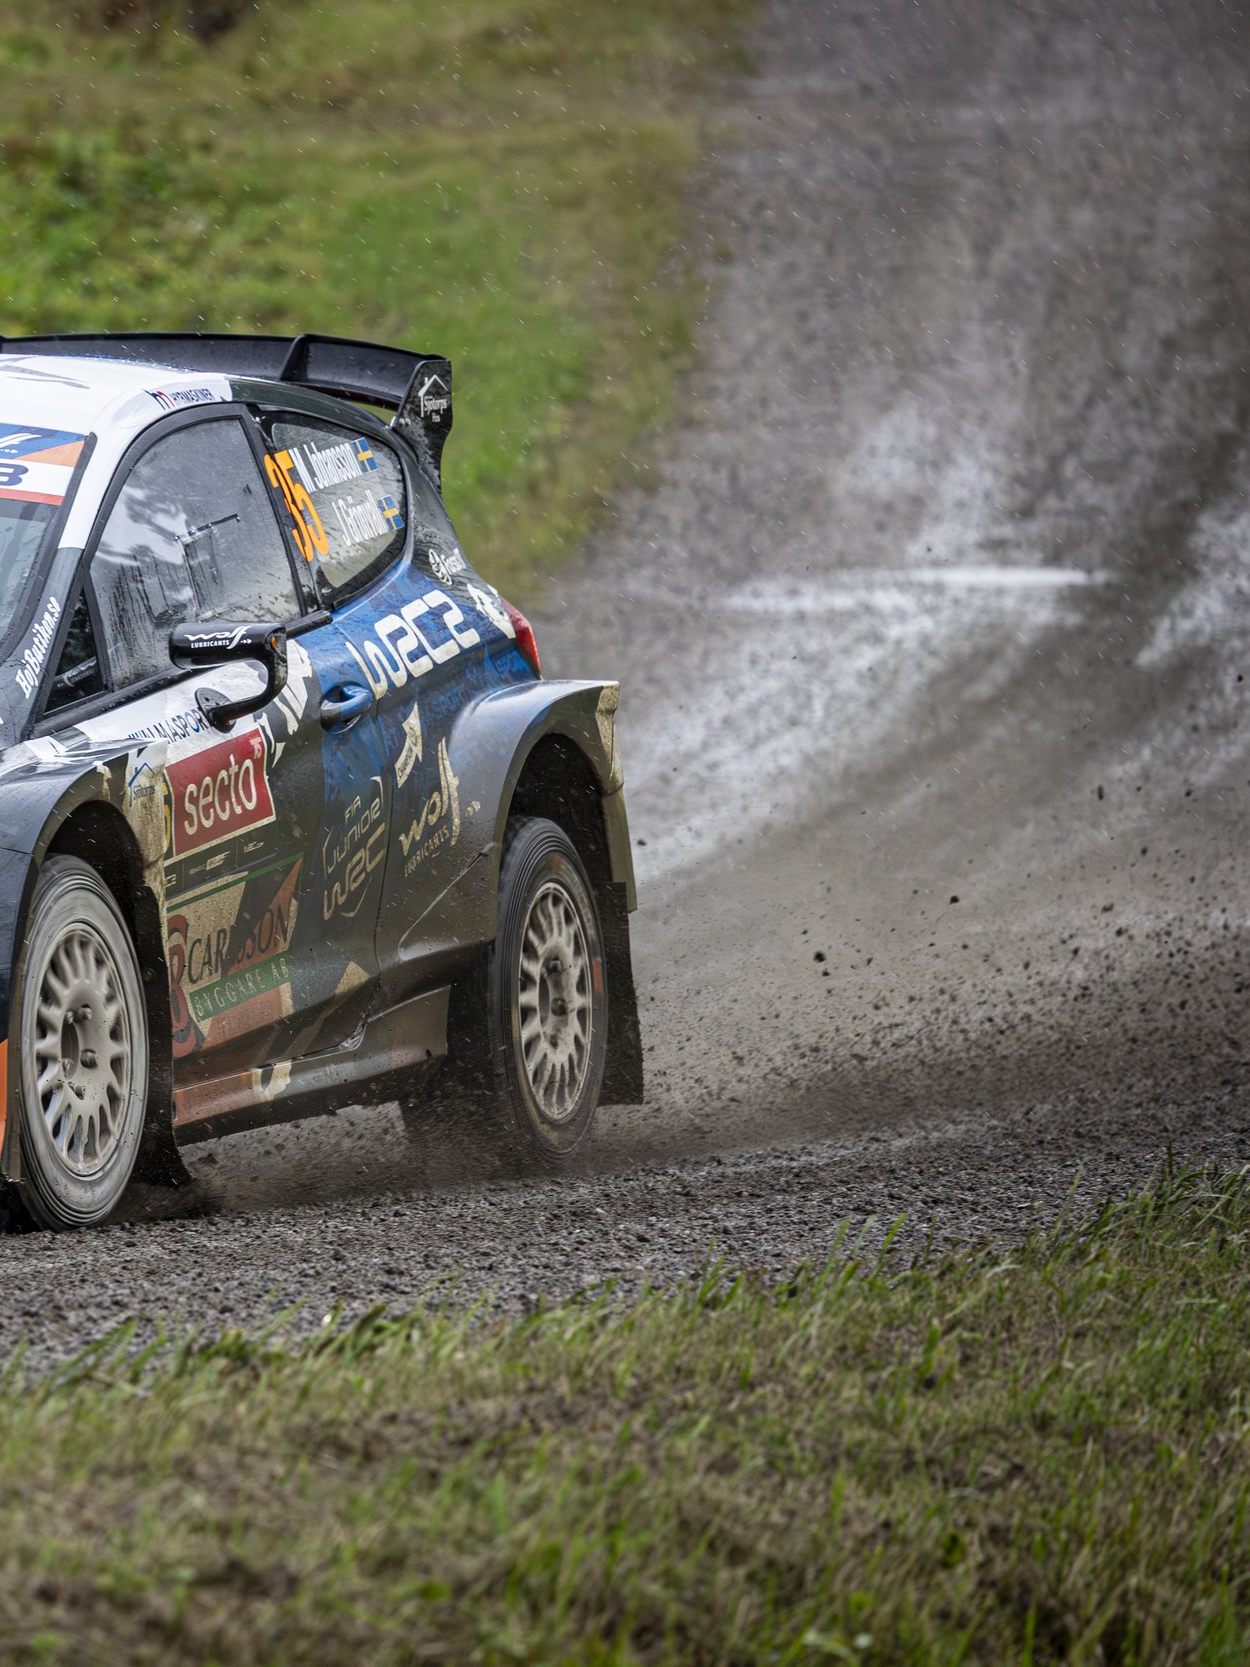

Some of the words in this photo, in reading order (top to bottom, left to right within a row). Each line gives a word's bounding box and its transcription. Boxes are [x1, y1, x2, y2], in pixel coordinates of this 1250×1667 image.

[263, 449, 331, 562] 35
[190, 640, 230, 649] LUBRICANTS
[183, 753, 258, 837] secto
[327, 797, 381, 874] JUNIOR
